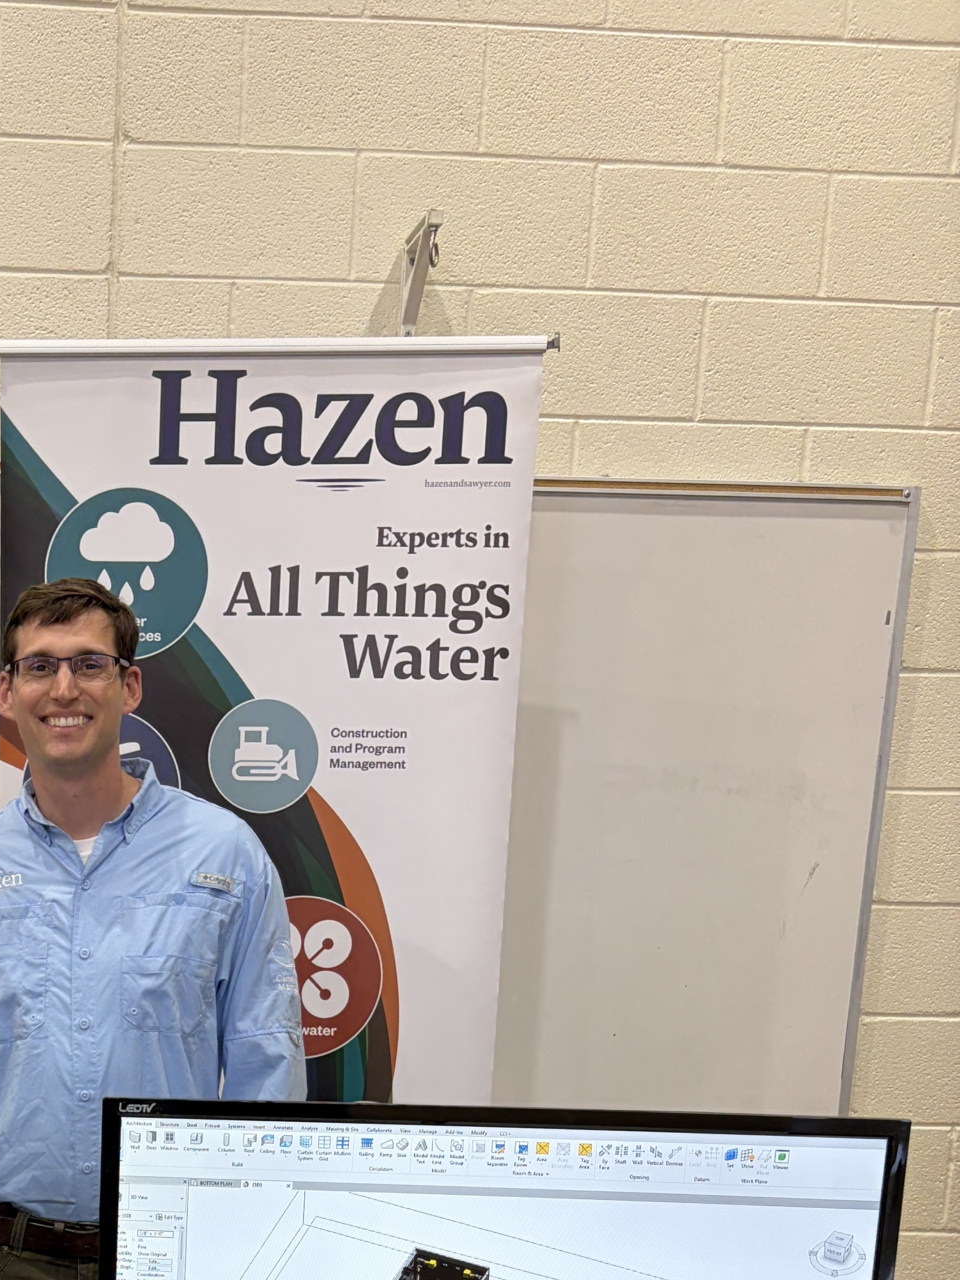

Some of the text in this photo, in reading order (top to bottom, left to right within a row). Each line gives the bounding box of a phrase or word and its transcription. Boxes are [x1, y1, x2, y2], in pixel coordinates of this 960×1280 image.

[149, 370, 514, 466] Hazen
[424, 479, 511, 489] hazenandsawyer.com
[376, 525, 510, 554] Experts in
[222, 565, 511, 634] All Things
[135, 618, 147, 627] er
[139, 633, 161, 641] ces
[339, 634, 510, 681] Water
[331, 728, 407, 738] Construction
[330, 743, 405, 756] and Program
[330, 758, 406, 771] Management
[302, 1026, 337, 1036] water
